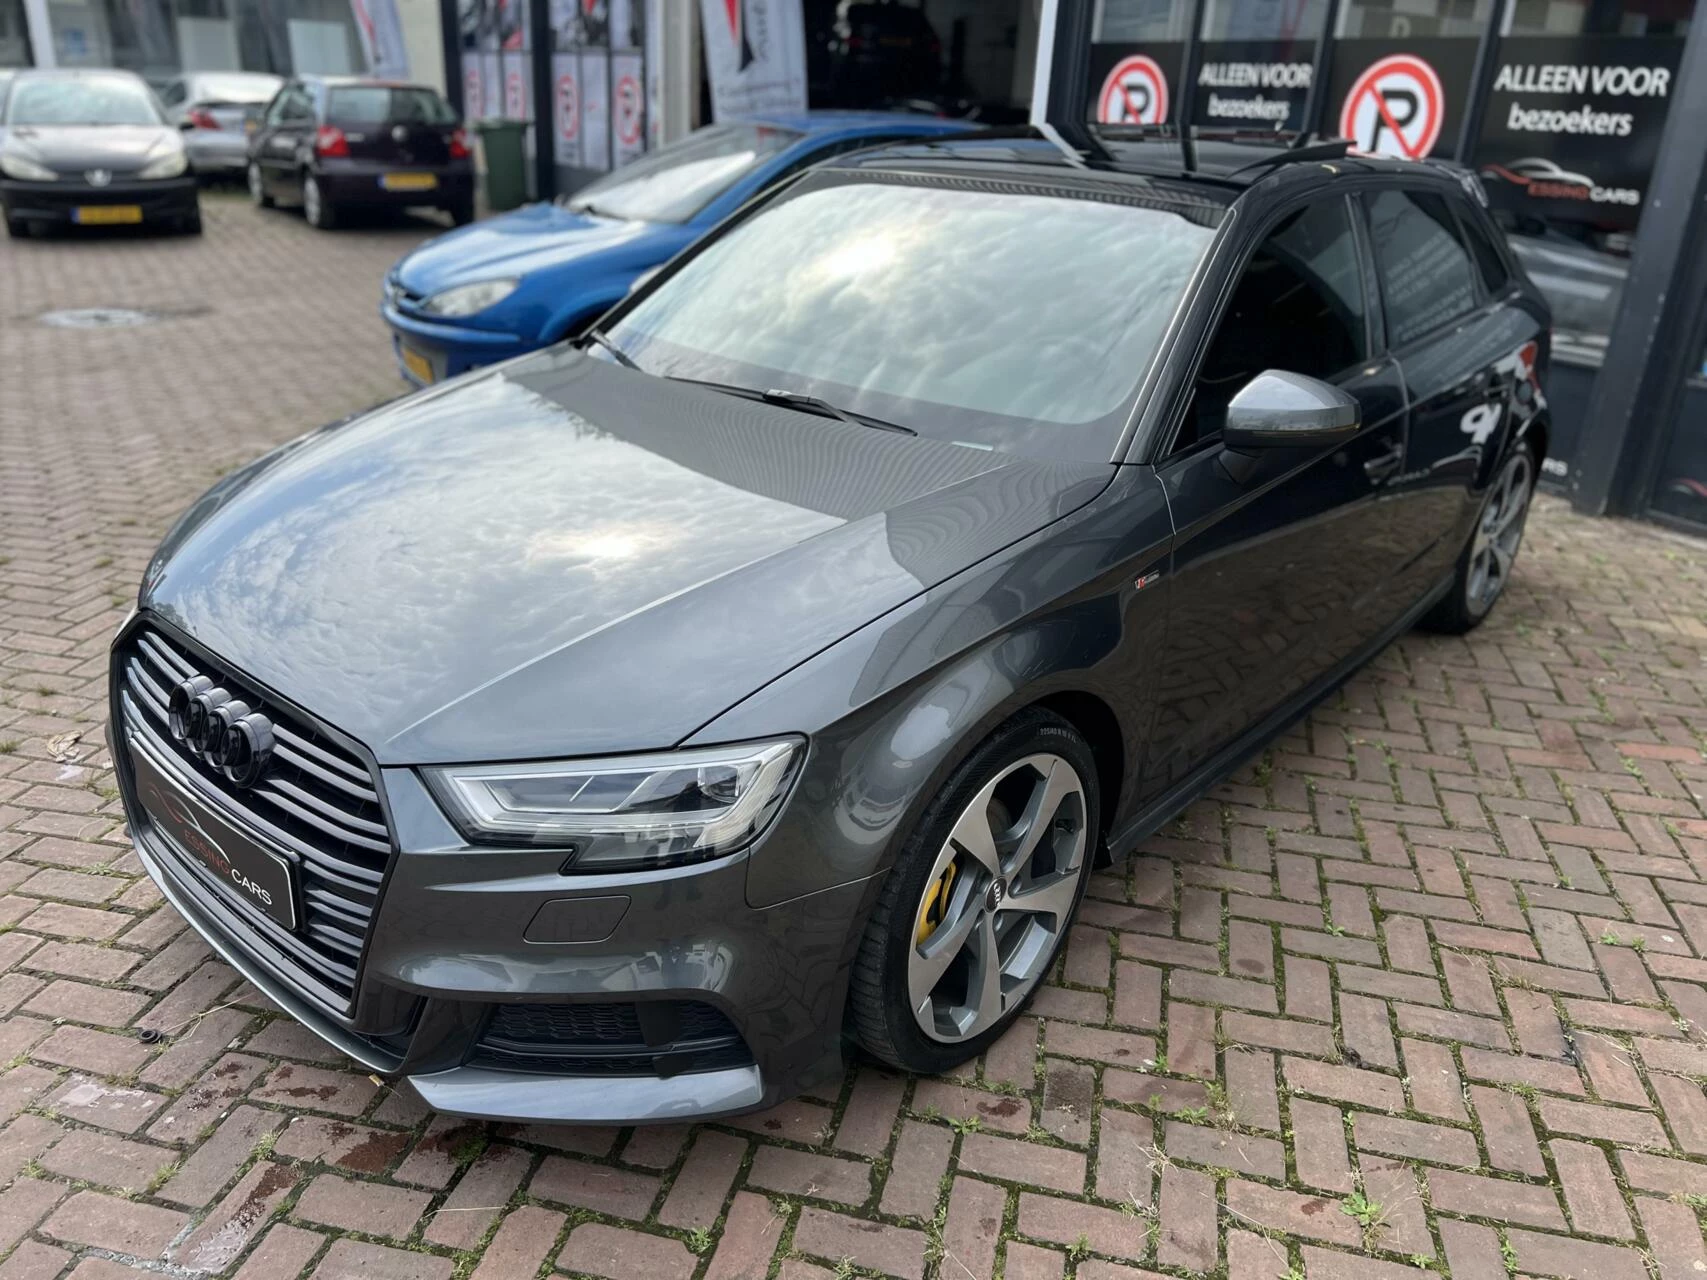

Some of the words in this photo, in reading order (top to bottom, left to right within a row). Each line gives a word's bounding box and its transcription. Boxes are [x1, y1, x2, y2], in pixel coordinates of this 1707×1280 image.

[1198, 62, 1260, 87] ALLEEN
[1259, 63, 1313, 88] VOOR
[1493, 64, 1589, 93] ALLEEN
[1591, 66, 1671, 96] VOOR
[1207, 94, 1290, 121] bezoekers
[1507, 101, 1634, 136] bezoekers
[1589, 187, 1641, 206] CARS
[184, 829, 230, 875] ESSING
[231, 868, 273, 906] CARS
